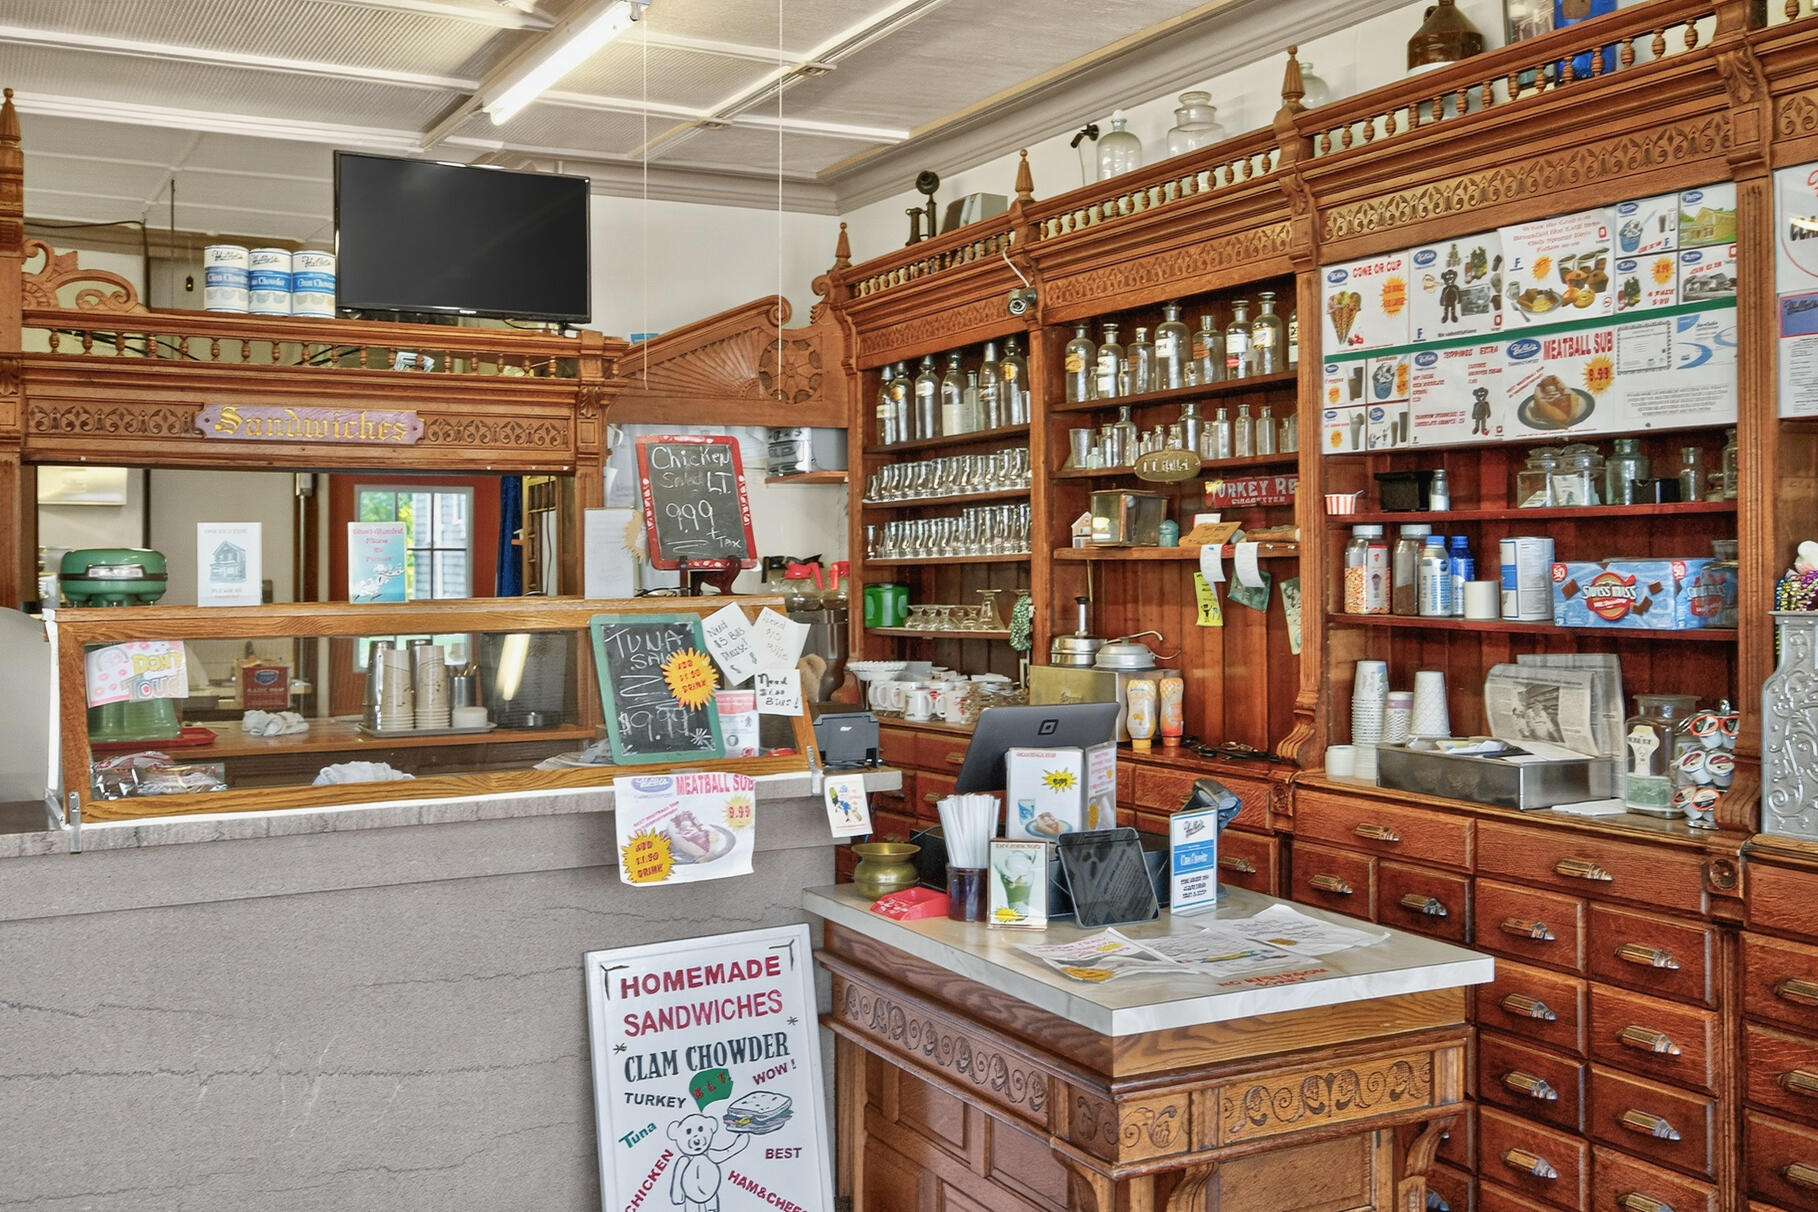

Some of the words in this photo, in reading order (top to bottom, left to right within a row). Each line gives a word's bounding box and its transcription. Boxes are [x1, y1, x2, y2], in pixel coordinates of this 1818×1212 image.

[1543, 334, 1591, 360] MEATBALL
[1593, 331, 1613, 353] SUB
[214, 406, 409, 441] Sandwiches
[604, 627, 684, 659] TUNA
[676, 774, 730, 795] MEATBALL
[733, 773, 756, 791] SUB
[637, 863, 664, 878] DRINK
[621, 955, 781, 999] HOMEMADE
[623, 989, 783, 1037] SANDWICHES
[624, 1049, 679, 1083] CLAM
[685, 1031, 791, 1071] CHOWDER
[624, 1092, 687, 1109] TURKEY
[618, 1121, 657, 1149] Tuna
[765, 1147, 802, 1159] BEST
[625, 1148, 674, 1212] CHICKEN
